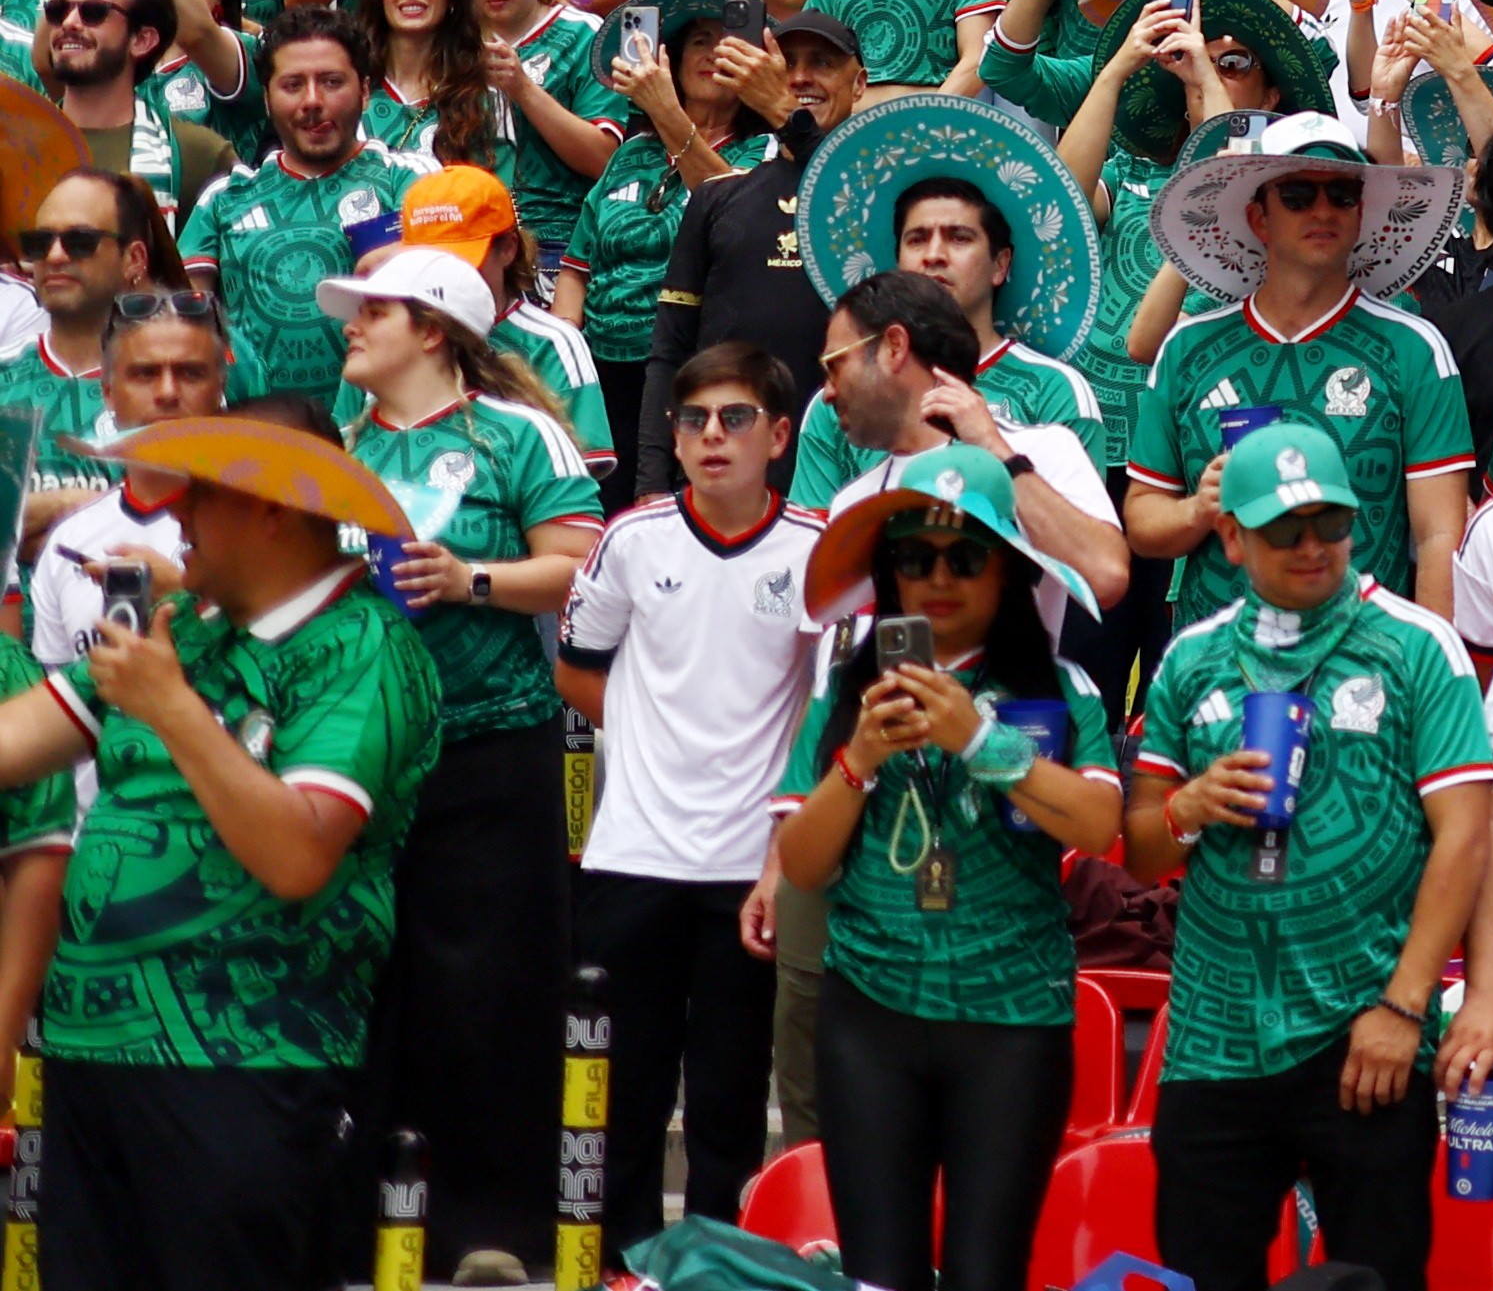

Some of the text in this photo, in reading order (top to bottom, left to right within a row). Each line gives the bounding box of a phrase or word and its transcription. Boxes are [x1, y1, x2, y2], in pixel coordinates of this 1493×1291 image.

[879, 100, 909, 117] FIFA
[1033, 140, 1054, 161] FIFA
[1078, 205, 1093, 233] FIFA
[1437, 214, 1455, 241] FIFA
[1392, 273, 1414, 293] FIFA
[585, 1062, 603, 1121] FILA
[1447, 1136, 1493, 1152] ULTRA
